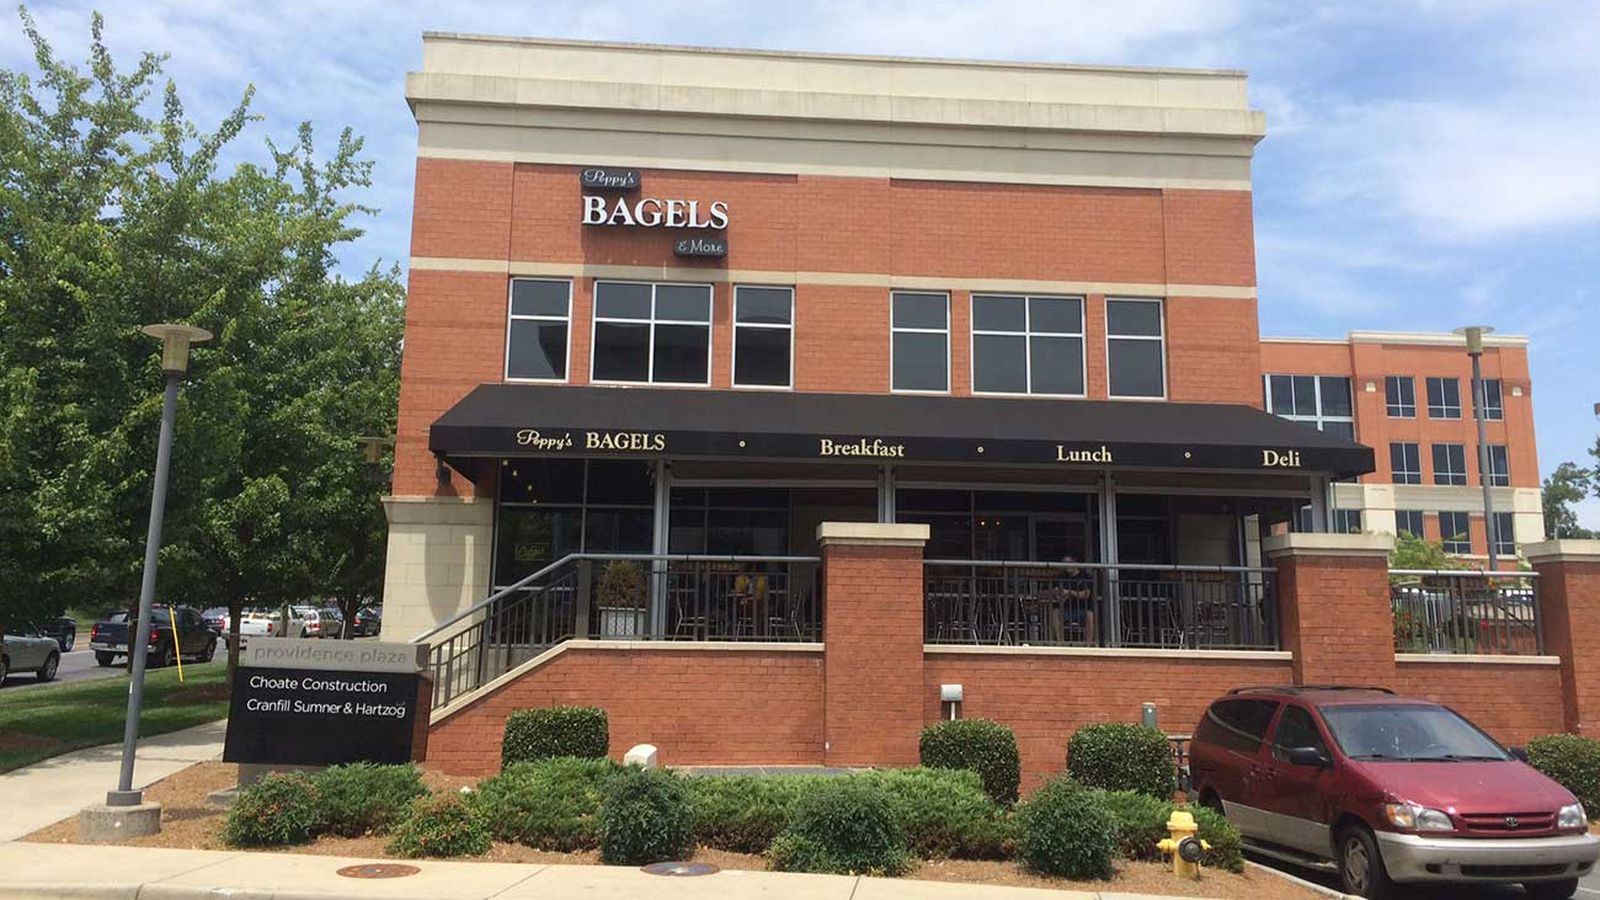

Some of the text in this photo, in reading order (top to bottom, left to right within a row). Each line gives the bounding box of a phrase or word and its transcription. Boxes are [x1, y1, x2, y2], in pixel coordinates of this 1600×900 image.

[584, 169, 635, 186] Poppy's
[581, 195, 729, 230] BAGELS
[689, 239, 724, 253] More
[516, 429, 1301, 467] Poppy's BAGELS Breakfast Lunch Deli
[254, 646, 408, 664] providence plaza
[250, 675, 388, 693] Choate Construction
[246, 698, 406, 718] Cranfill Sumner & Hartzog
